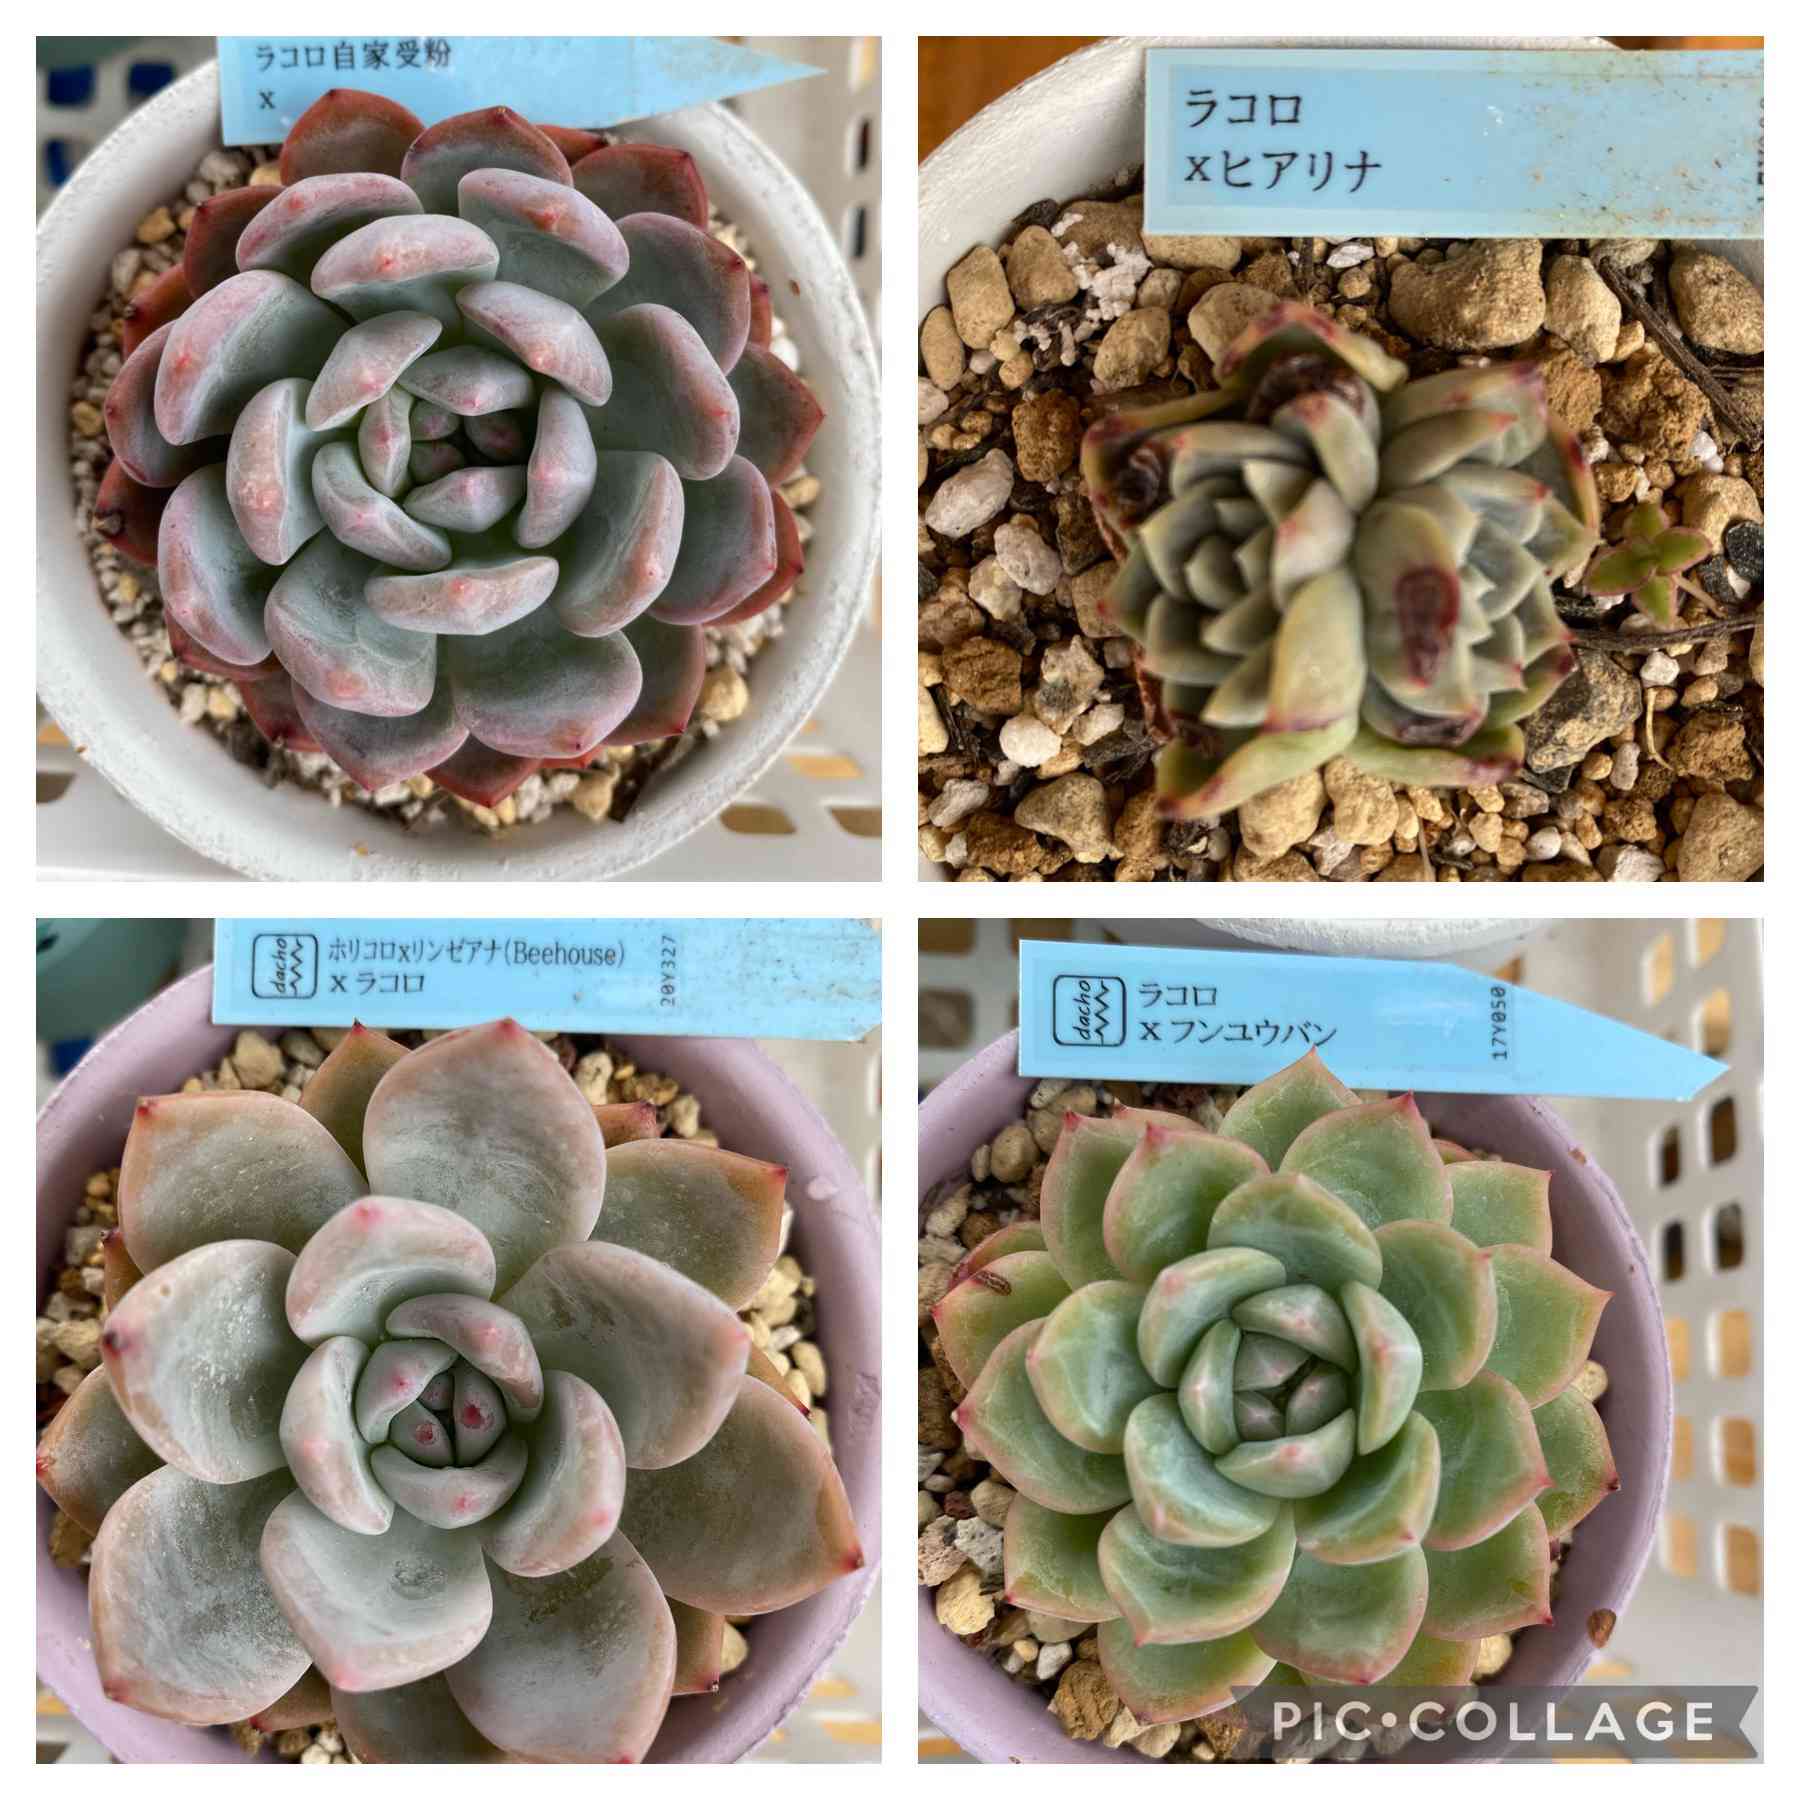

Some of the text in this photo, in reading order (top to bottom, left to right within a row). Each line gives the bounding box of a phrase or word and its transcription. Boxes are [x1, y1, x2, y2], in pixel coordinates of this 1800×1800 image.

[256, 38, 451, 71] ラコロ自家受粉
[1184, 88, 1303, 127] ラコロ
[270, 937, 287, 993] dacho
[356, 972, 425, 995] ラコロ
[660, 934, 677, 1007] 20Y327
[1073, 980, 1091, 1040] dacho
[1138, 983, 1217, 1008] ラコロ
[1170, 1019, 1338, 1047] フンユウバン
[1491, 985, 1506, 1060] 17Y050
